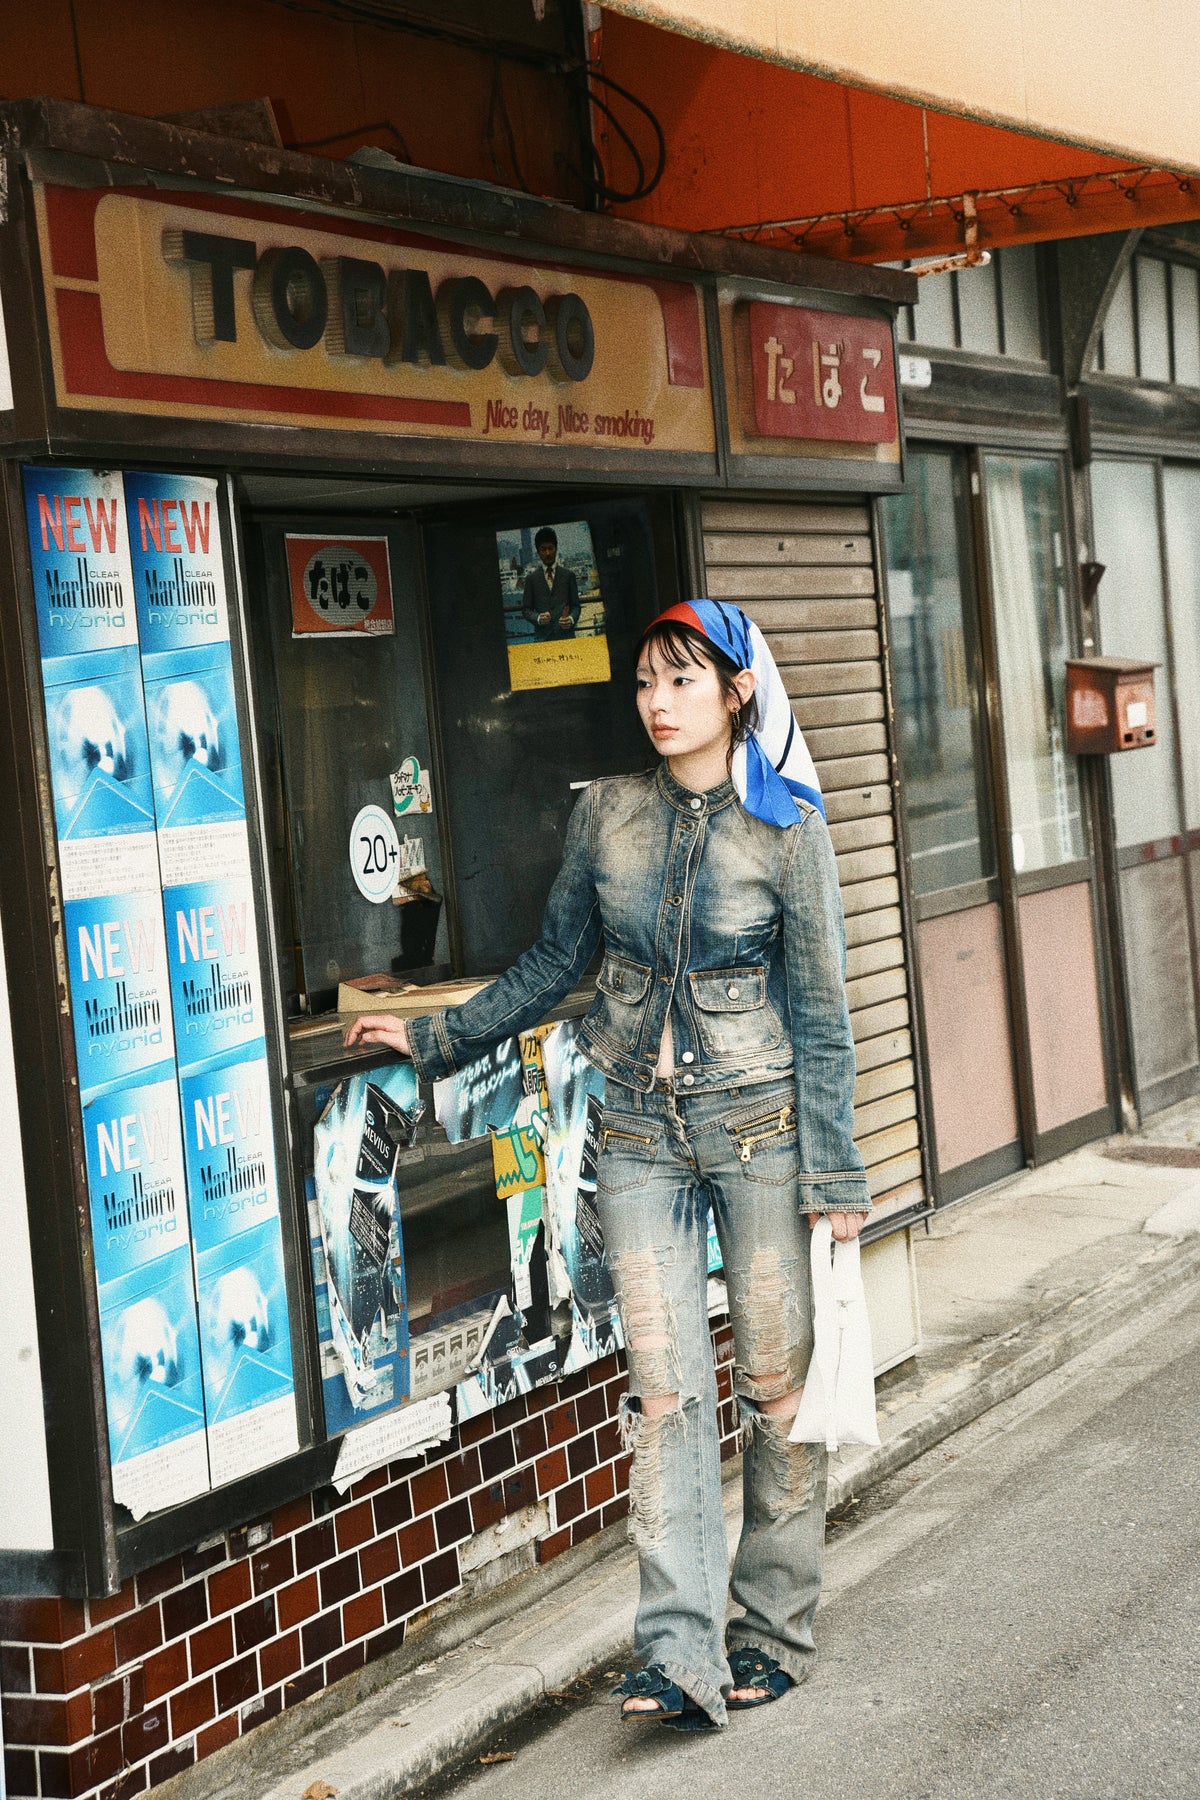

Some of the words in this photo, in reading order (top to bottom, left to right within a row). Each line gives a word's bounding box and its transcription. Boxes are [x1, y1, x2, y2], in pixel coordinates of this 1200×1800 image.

[164, 230, 595, 382] TOBACCO
[764, 336, 885, 413] たばこ
[482, 399, 519, 434] Nice
[556, 404, 590, 438] Nice
[38, 494, 118, 553] NEW
[137, 498, 210, 554] NEW
[46, 558, 124, 609] Marlboro
[89, 571, 120, 579] CLEAR
[145, 558, 216, 607] Marlboro
[185, 570, 213, 578] CLEAR
[308, 560, 370, 611] たばこ
[49, 611, 126, 631] hybrid
[148, 609, 219, 628] hybrid
[360, 834, 398, 875] 20+
[78, 917, 156, 982] NEW
[176, 902, 248, 964] NEW
[127, 988, 158, 1000] CLEAR
[182, 963, 252, 1017] Marlboro
[222, 970, 249, 981] CLEAR
[85, 981, 161, 1037] Marlboro
[185, 1008, 254, 1036] hybrid
[88, 1028, 163, 1057] hybrid
[236, 1151, 263, 1164] CLEAR
[364, 1122, 390, 1159] MEVIUS
[585, 1131, 599, 1154] MEVI
[143, 1177, 172, 1190] CLEAR
[200, 1147, 266, 1202] Marlboro
[104, 1172, 175, 1230] Marlboro
[203, 1190, 268, 1222] hybrid
[107, 1216, 177, 1250] hybrid
